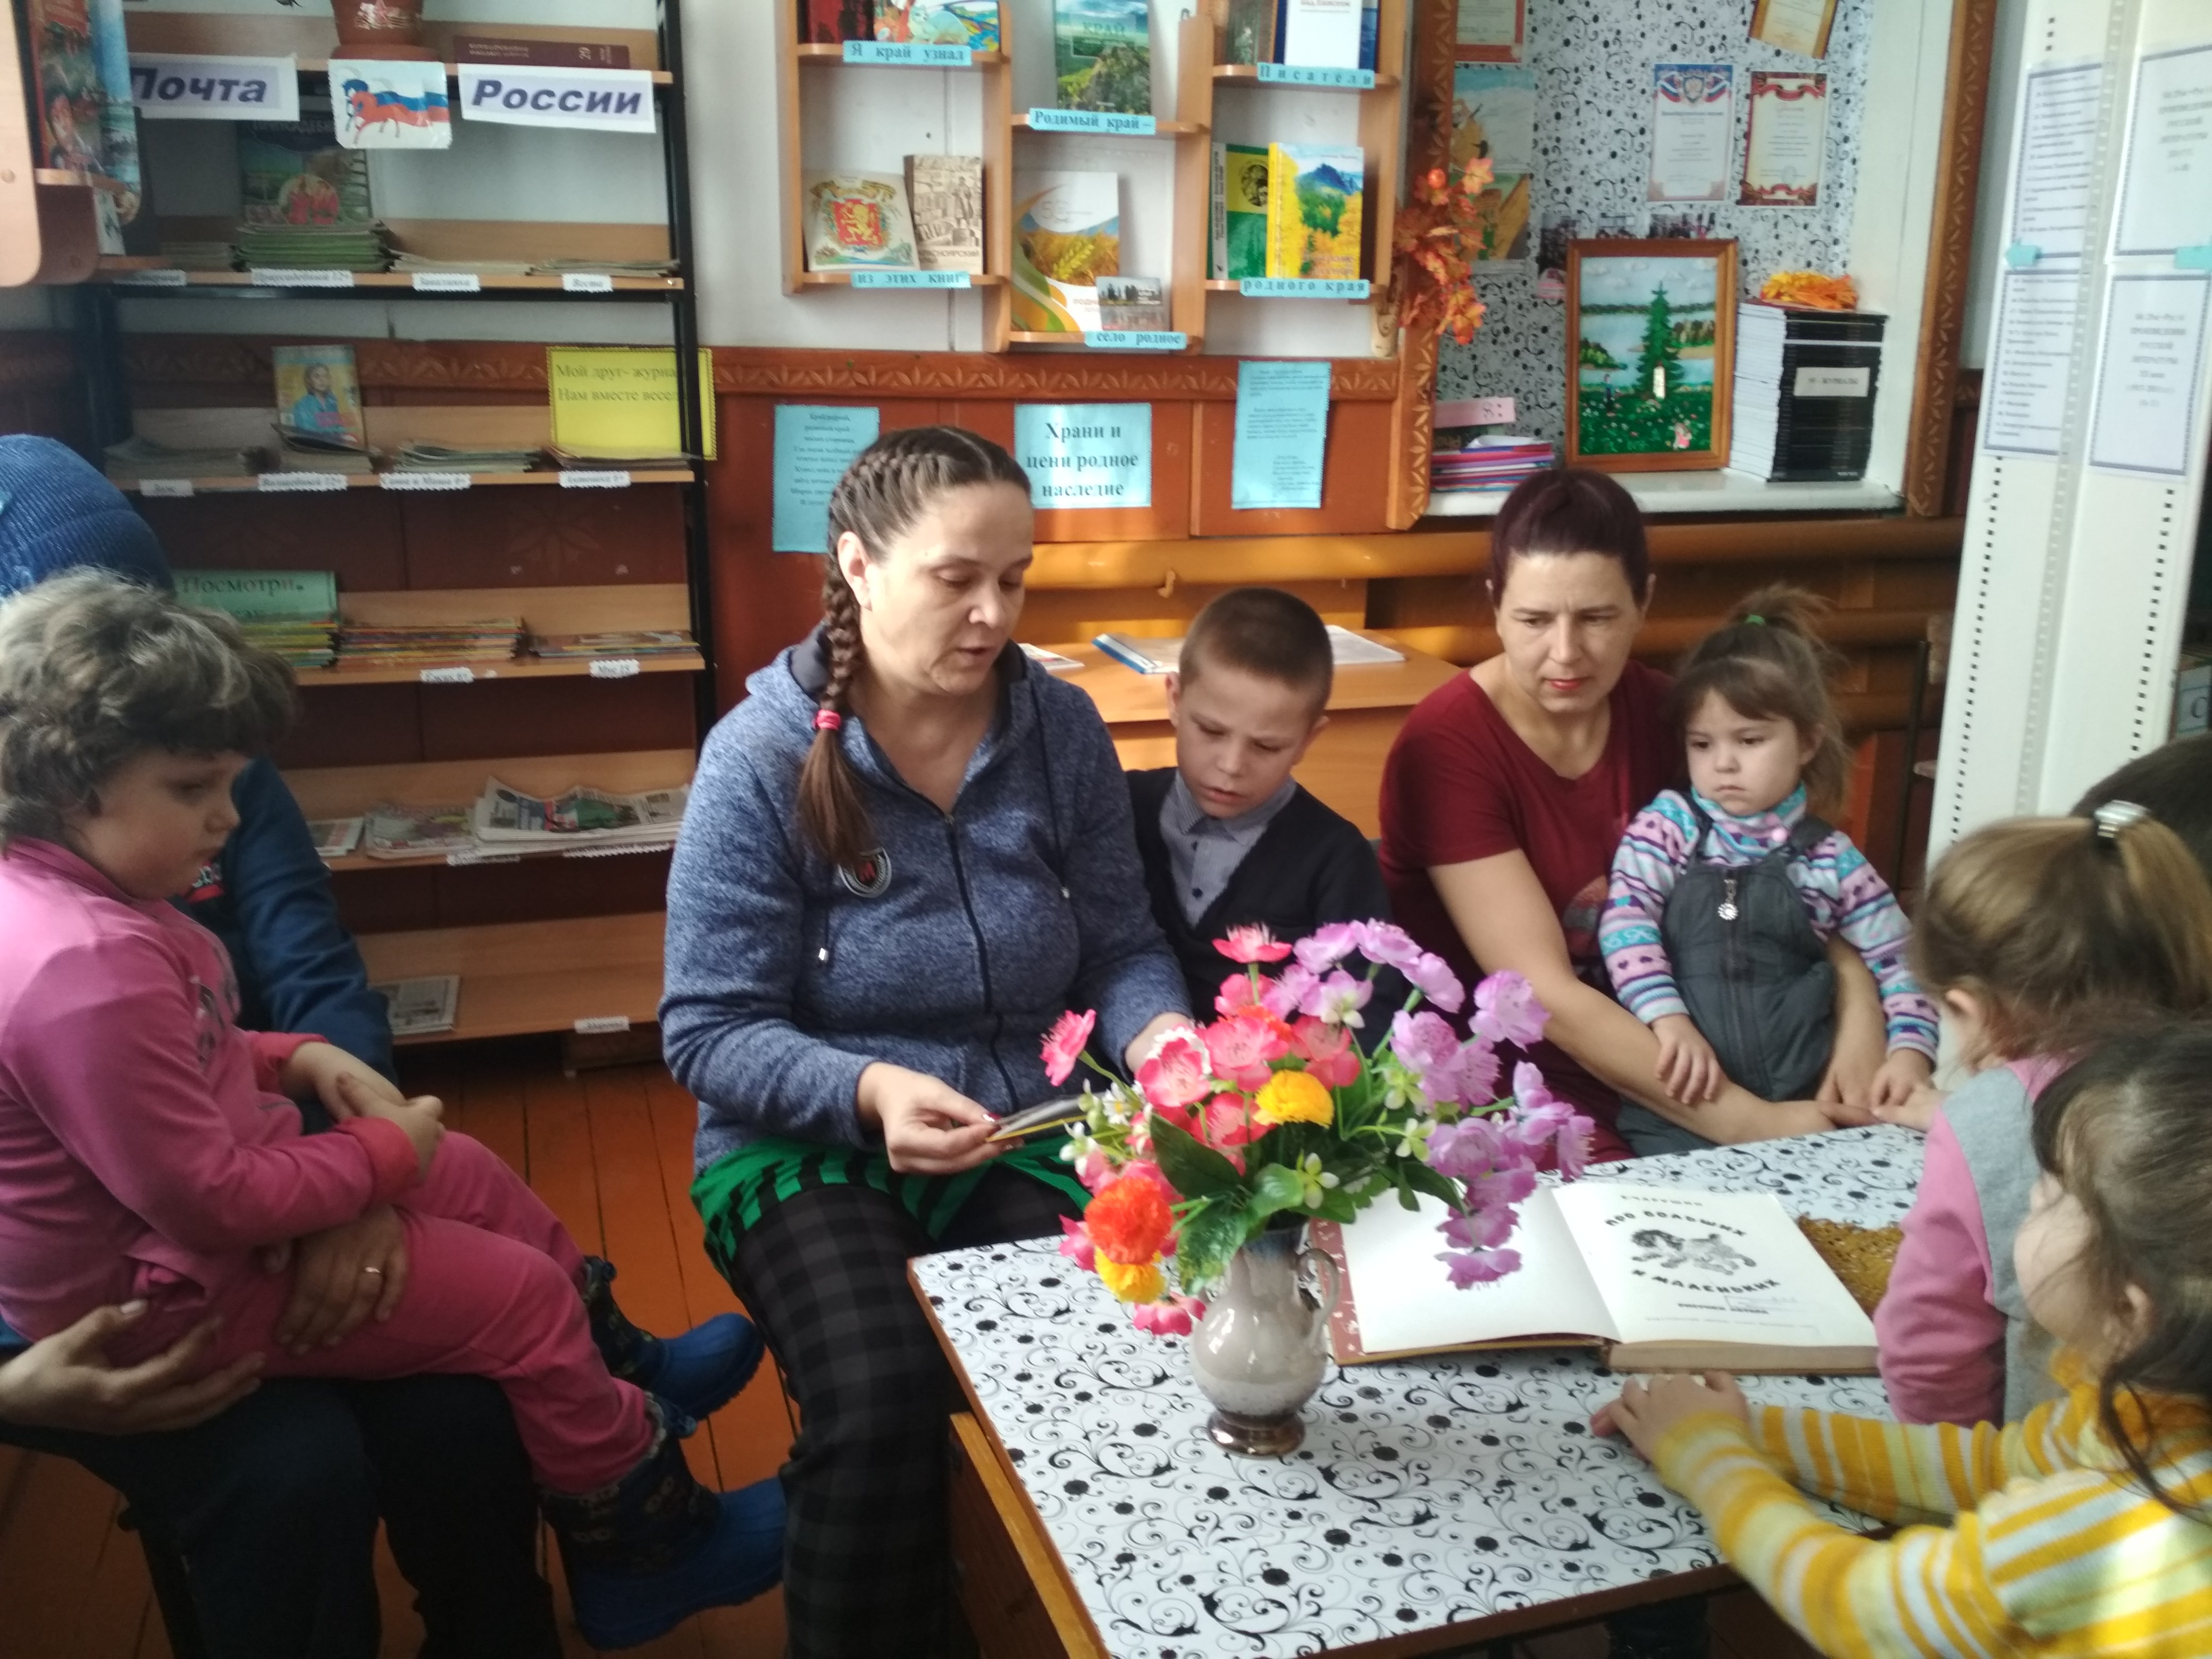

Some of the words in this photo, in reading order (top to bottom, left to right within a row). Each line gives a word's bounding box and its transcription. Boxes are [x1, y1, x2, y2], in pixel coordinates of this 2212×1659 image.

[851, 44, 863, 56] Я
[875, 46, 911, 60] край
[923, 49, 964, 62] узнал
[1260, 65, 1371, 85] Писатели
[131, 67, 267, 103] Почта
[472, 79, 642, 115] России
[1035, 111, 1099, 127] Родимый
[1107, 117, 1139, 131] край
[858, 274, 873, 284] из
[885, 274, 917, 283] этих
[928, 273, 963, 283] книг
[1244, 280, 1316, 292] родного
[1325, 282, 1365, 293] края
[1096, 333, 1126, 342] село
[1136, 334, 1180, 346] родное
[556, 364, 589, 378] Мой
[632, 367, 678, 381] журна
[557, 388, 588, 401] Нам
[591, 390, 640, 401] вместе
[1044, 422, 1105, 443] Храни
[1110, 426, 1121, 438] и
[1026, 456, 1071, 470] цени
[1076, 455, 1139, 472] родное
[1042, 483, 1125, 497] наследие
[1605, 1212, 1636, 1226] ПРО
[1643, 1210, 1747, 1237] БОЛЬШИХ
[1652, 1275, 1780, 1294] МАЛЕНЬКИХ
